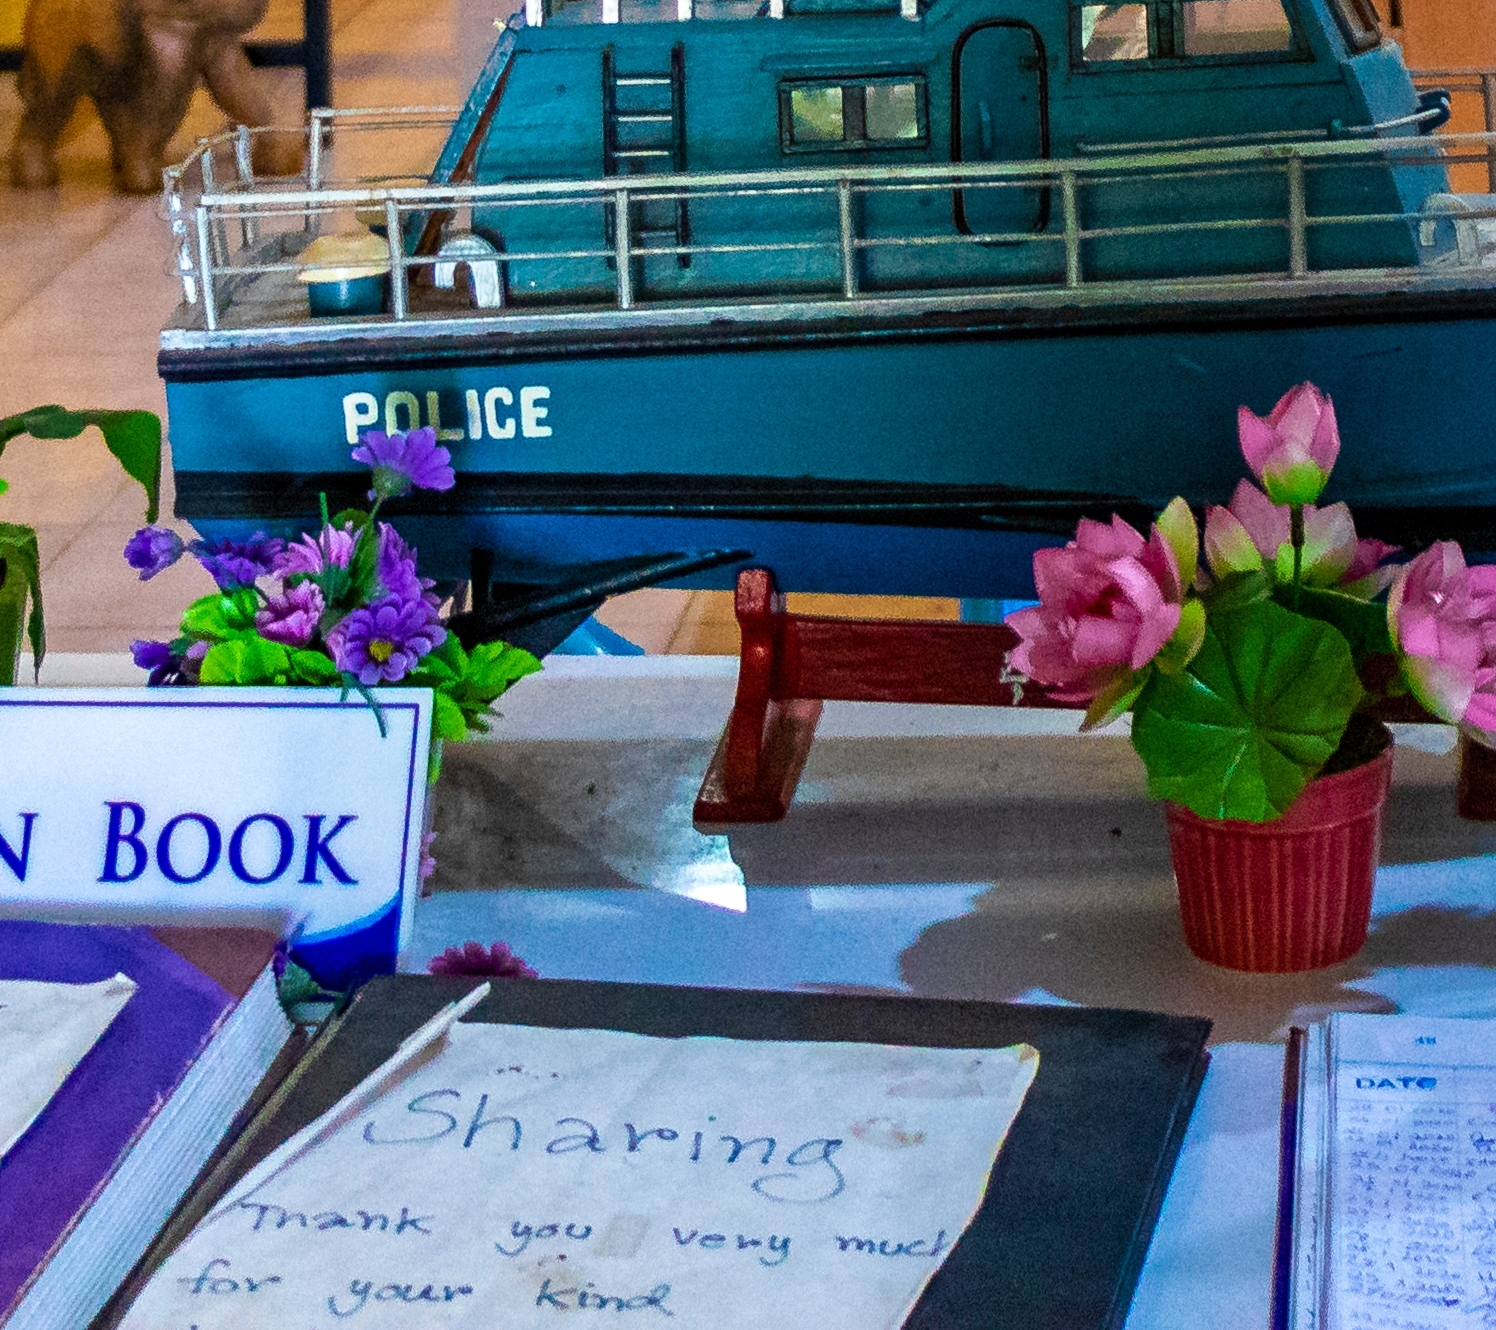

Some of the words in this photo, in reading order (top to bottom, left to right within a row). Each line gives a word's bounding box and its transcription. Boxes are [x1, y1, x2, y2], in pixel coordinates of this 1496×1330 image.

[341, 385, 553, 445] POLICE
[95, 797, 362, 888] BOOK
[361, 1087, 850, 1203] Sharing
[231, 1200, 436, 1238] Thank
[496, 1213, 595, 1263] you
[671, 1223, 797, 1268] very
[176, 1255, 285, 1299] for
[324, 1277, 478, 1320] your
[532, 1279, 678, 1319] kind
